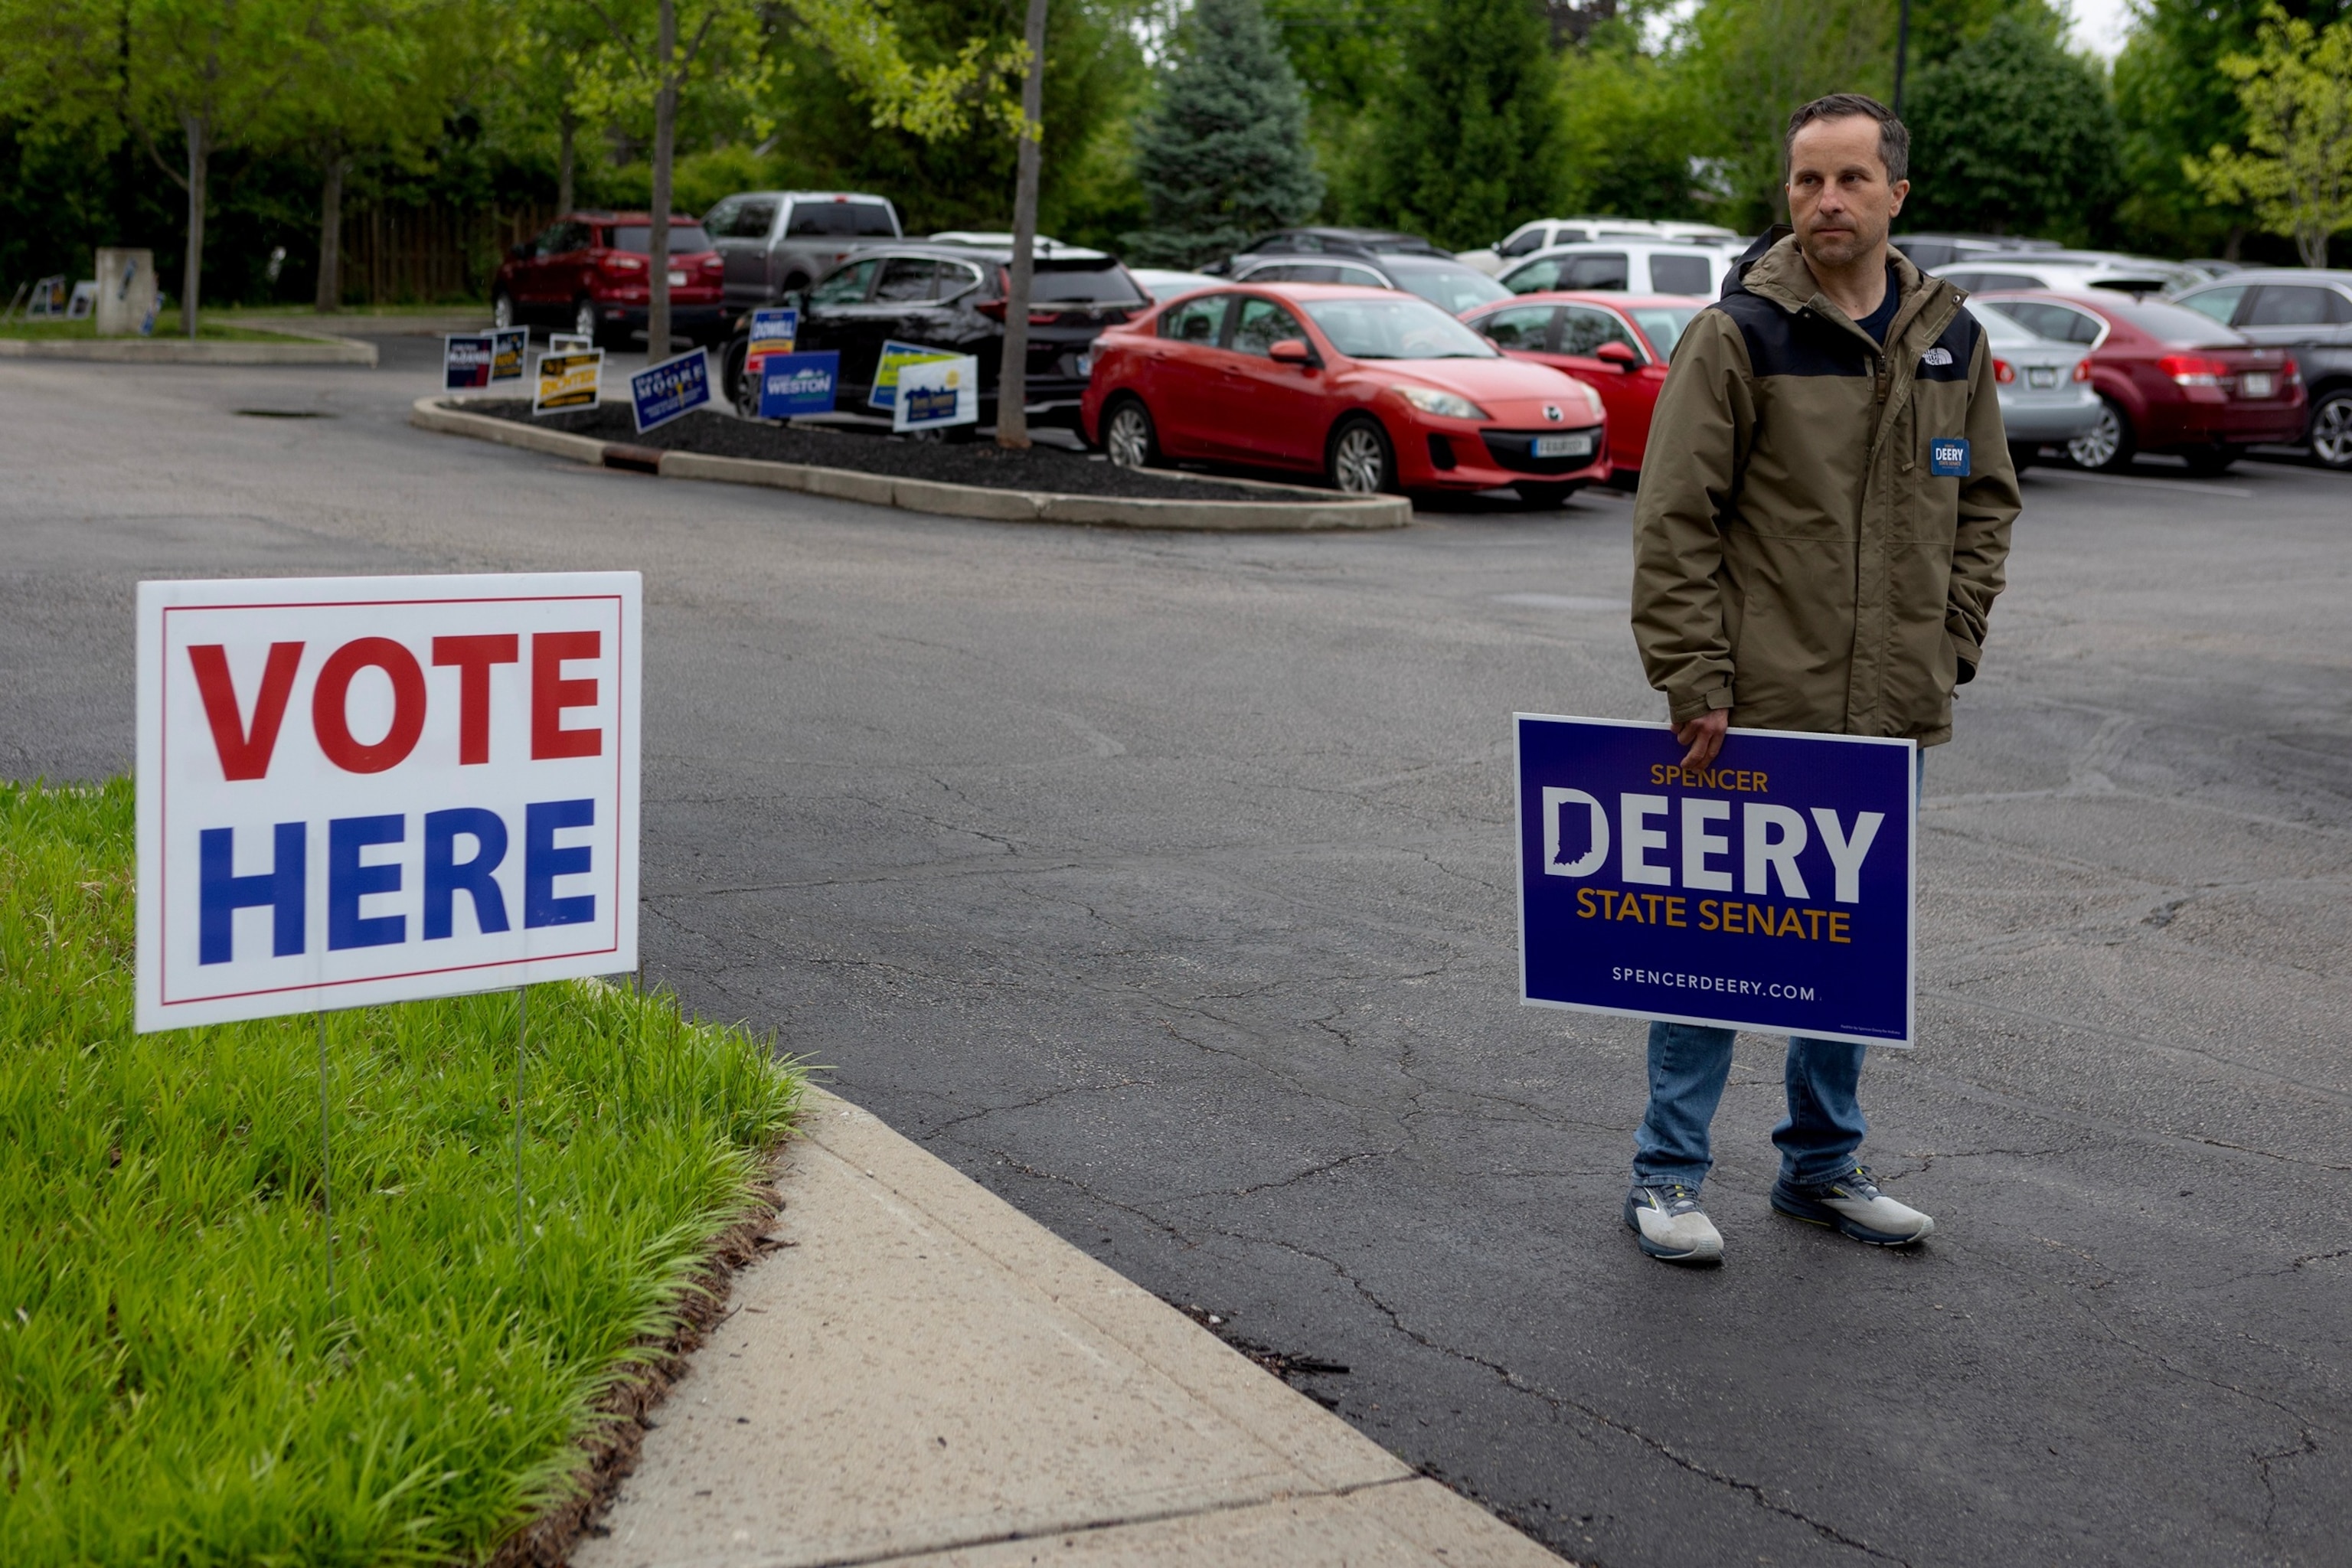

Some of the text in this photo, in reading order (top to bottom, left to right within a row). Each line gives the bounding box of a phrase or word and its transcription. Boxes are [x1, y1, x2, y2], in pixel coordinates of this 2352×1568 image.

[767, 374, 831, 395] WESTON
[1936, 448, 1963, 461] DEERY
[187, 631, 603, 782] VOTE
[1651, 764, 1769, 792] SPENCER
[1542, 786, 1886, 904] DEERY
[199, 799, 596, 965] HERE
[1576, 887, 1851, 943] STATE SENATE
[1612, 967, 1815, 1001] SPENCERDEERY.COM
